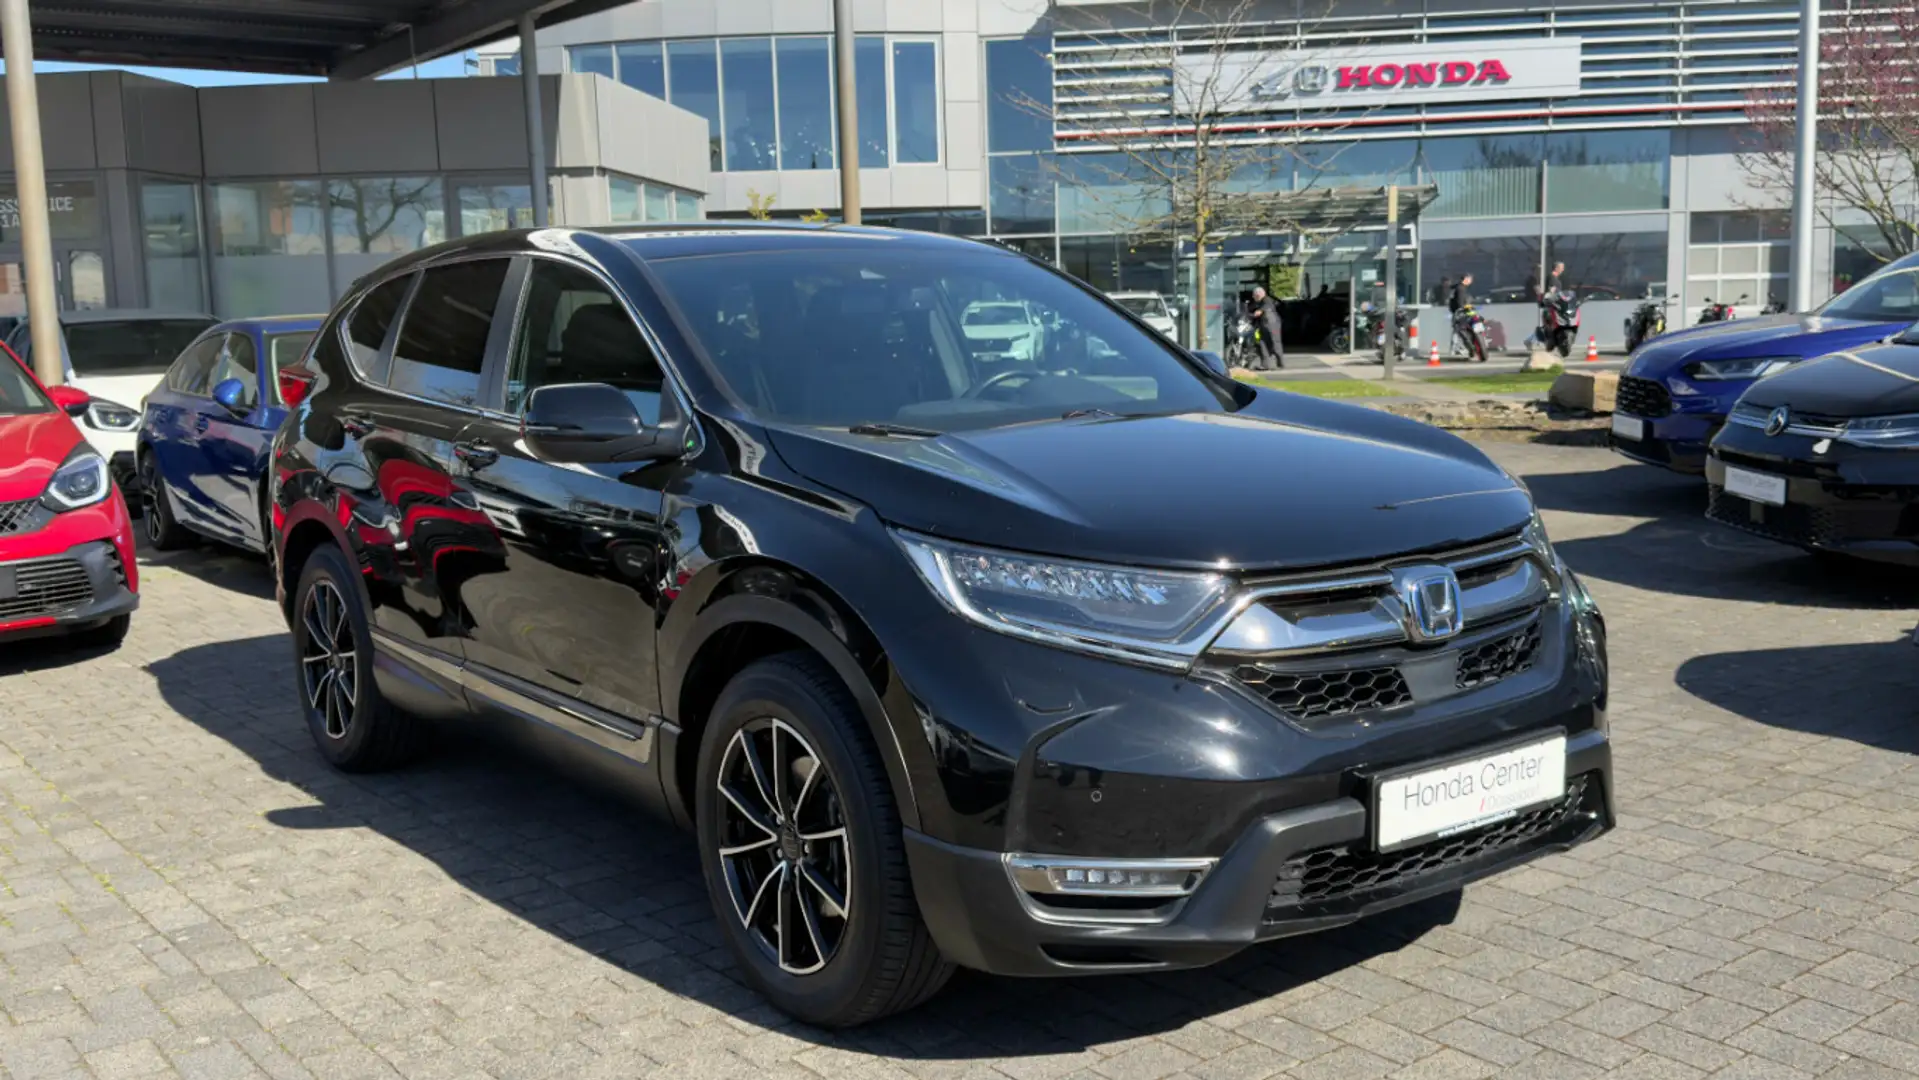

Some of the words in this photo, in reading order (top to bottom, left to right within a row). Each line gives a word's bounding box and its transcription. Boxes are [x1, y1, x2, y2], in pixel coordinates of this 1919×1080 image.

[1337, 59, 1511, 89] HONDA
[1403, 772, 1474, 811] Honda
[1480, 755, 1544, 790] Center
